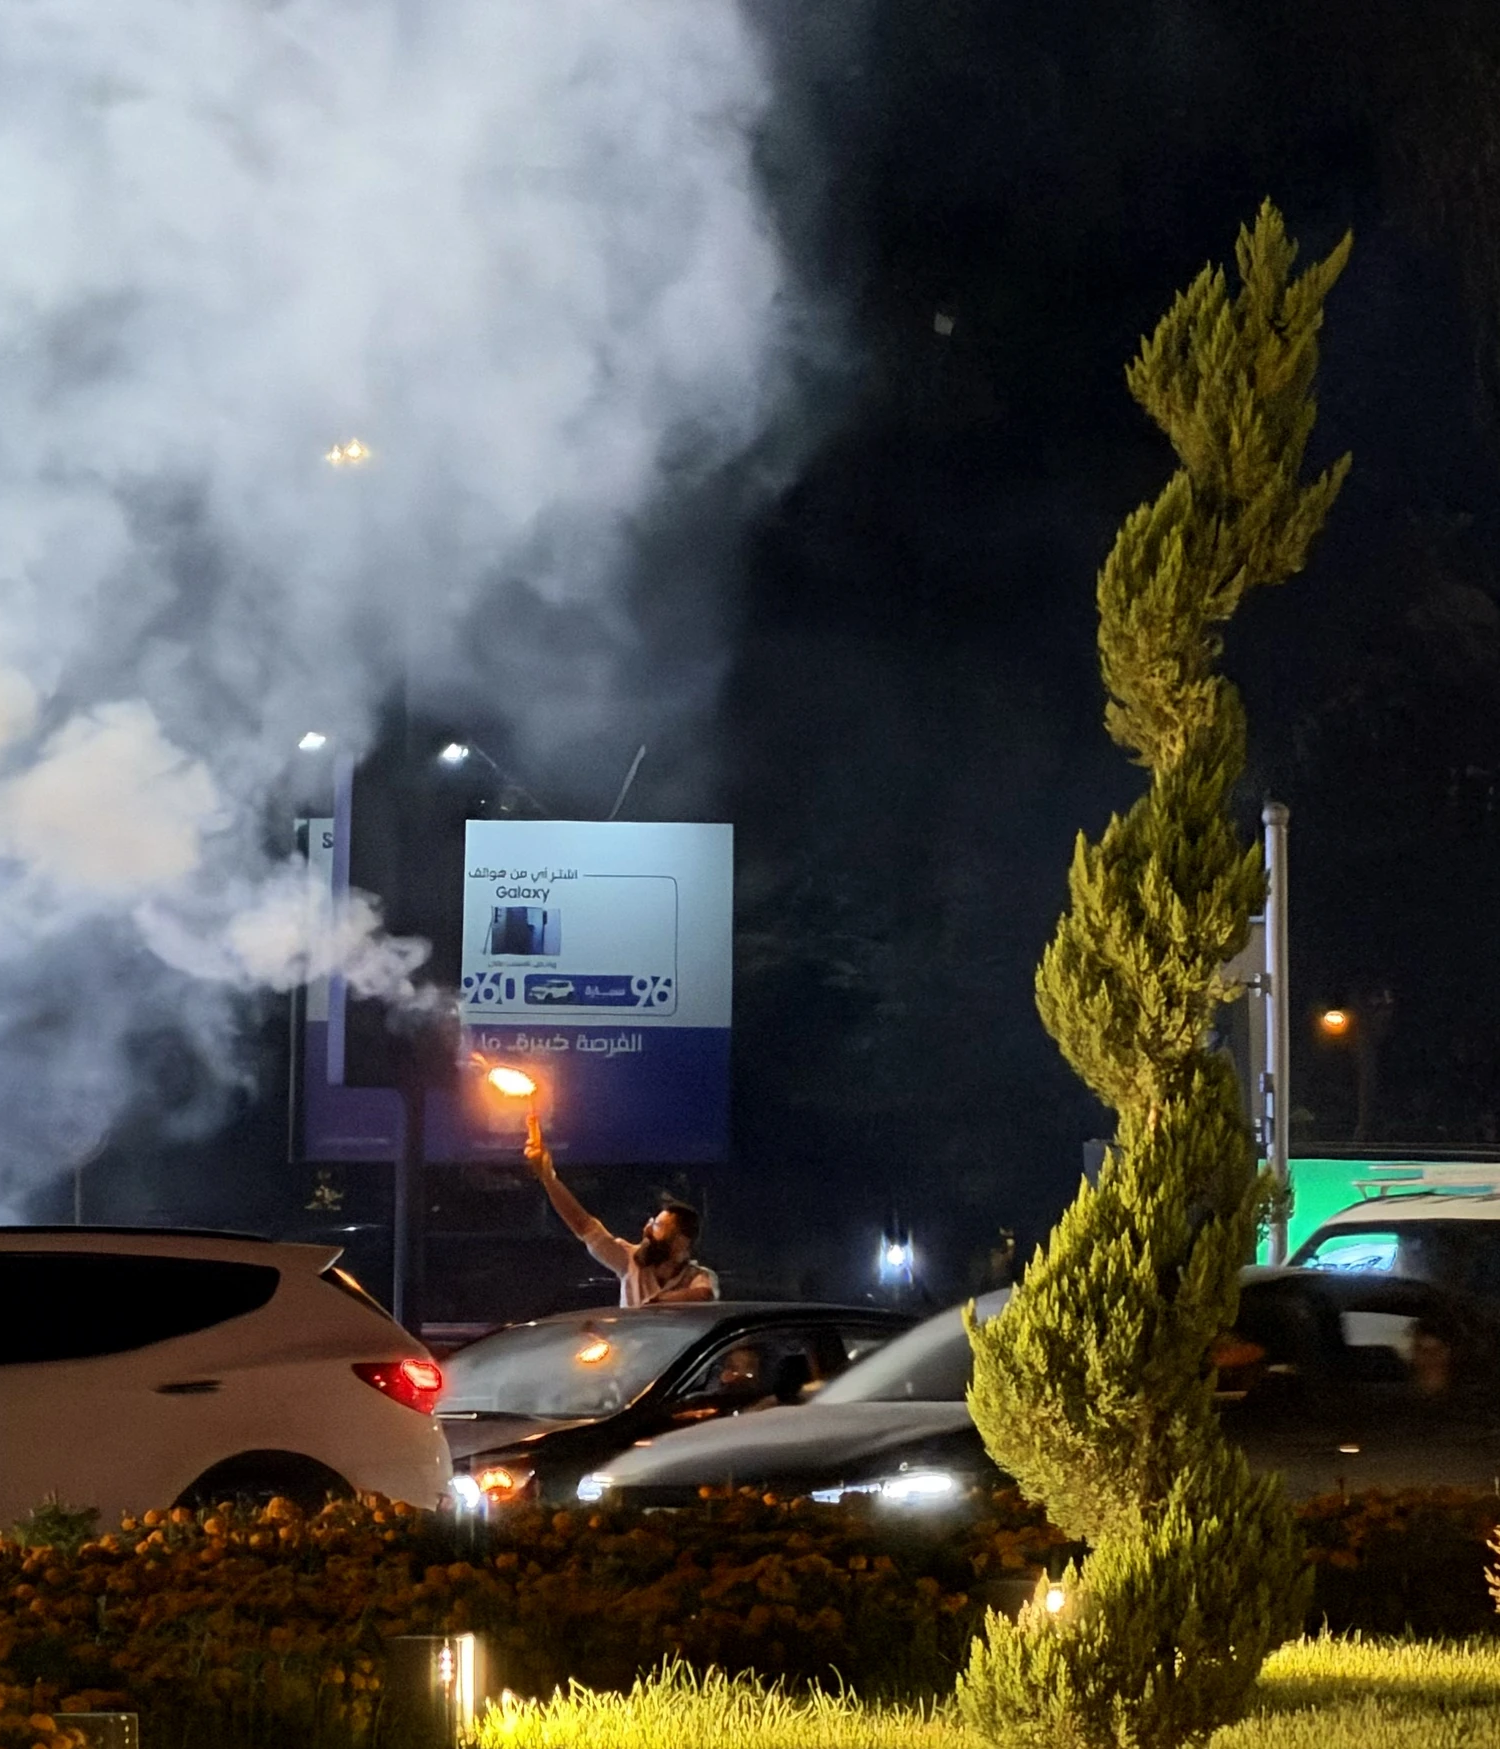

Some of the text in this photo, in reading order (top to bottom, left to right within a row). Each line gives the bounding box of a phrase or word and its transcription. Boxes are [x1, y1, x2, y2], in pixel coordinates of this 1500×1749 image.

[510, 868, 527, 880] من
[496, 886, 550, 903] Galaxy
[630, 973, 675, 1007] 96
[576, 1032, 642, 1058] الفرصة
